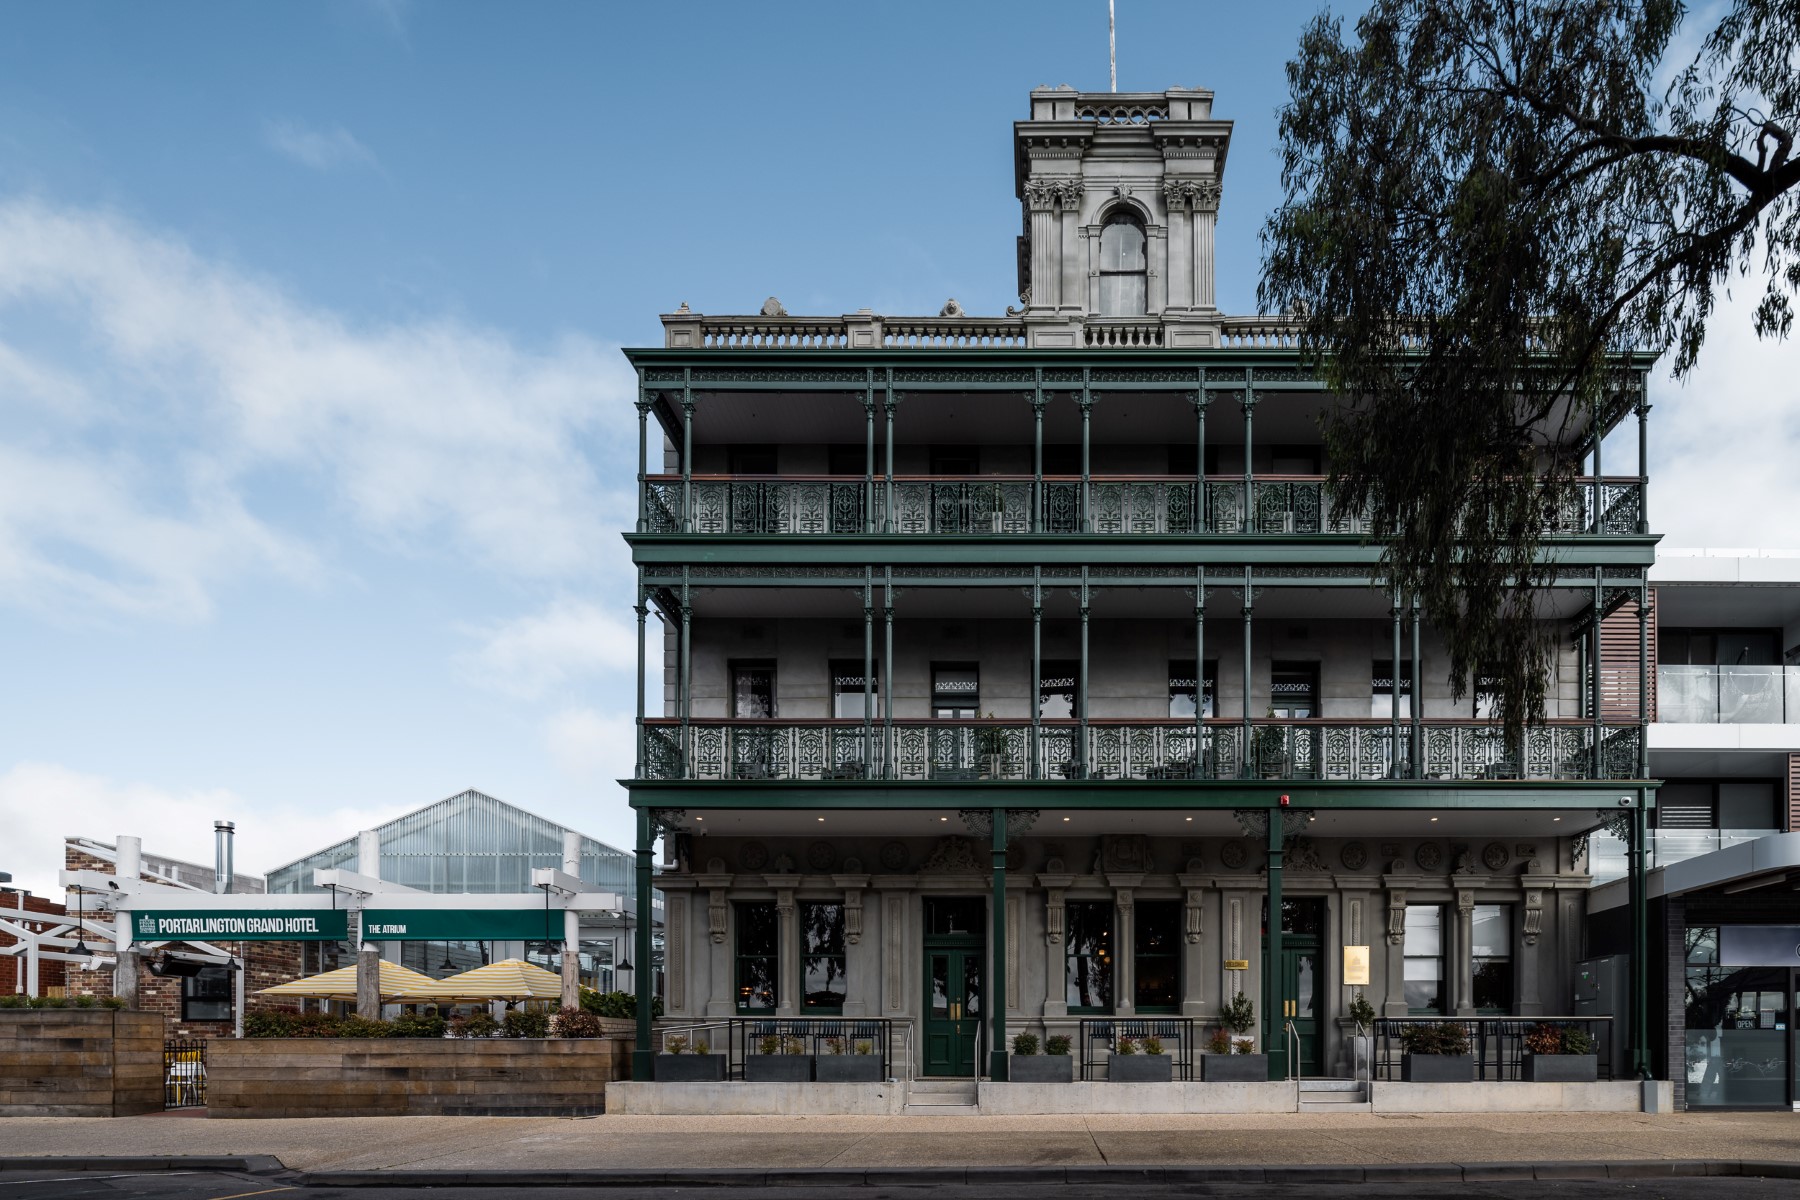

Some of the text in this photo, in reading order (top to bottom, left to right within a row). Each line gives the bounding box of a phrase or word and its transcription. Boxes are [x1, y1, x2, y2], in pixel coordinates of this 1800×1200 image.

[159, 917, 319, 933] PORTARLINGTON GRAND HOTEL
[368, 924, 407, 934] THE ATRIUM
[1737, 1020, 1753, 1028] OPEN
